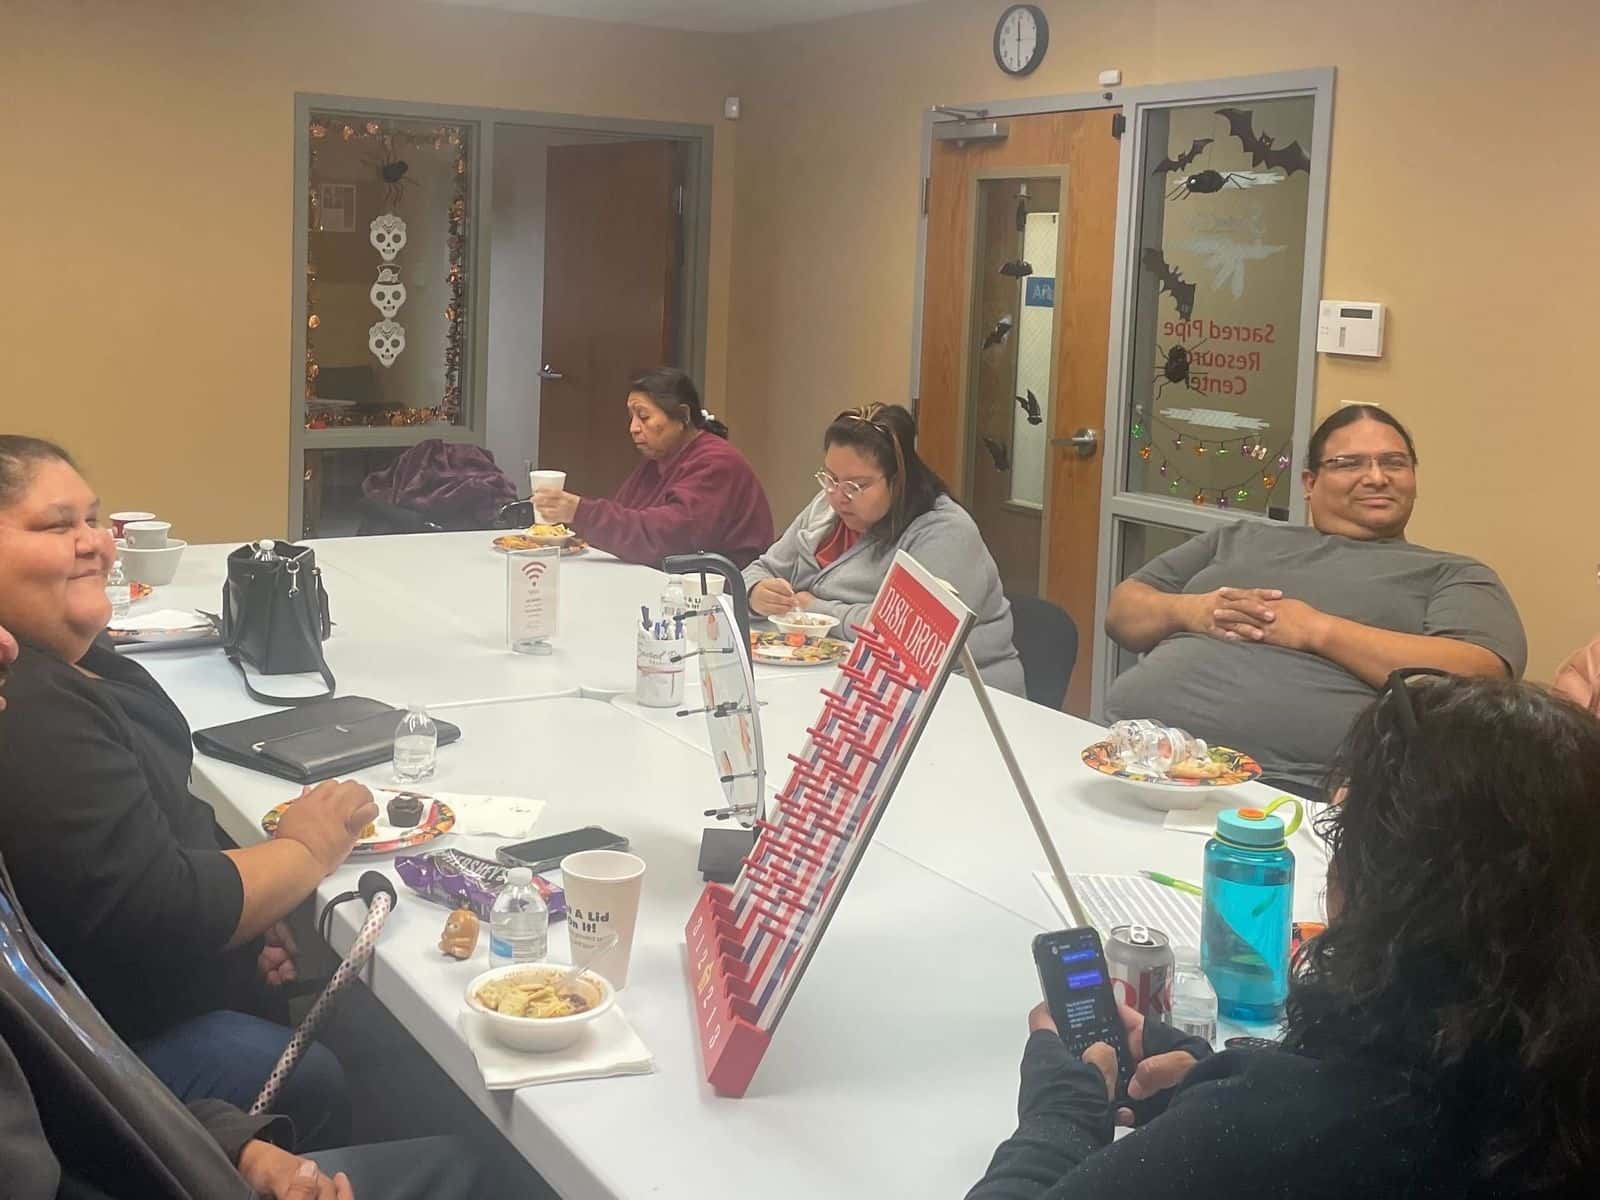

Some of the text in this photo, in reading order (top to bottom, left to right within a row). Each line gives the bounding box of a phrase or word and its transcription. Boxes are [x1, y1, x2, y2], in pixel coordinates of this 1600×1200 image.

[878, 586, 947, 675] DISK DROP
[575, 909, 583, 919] A
[588, 911, 609, 922] Lid
